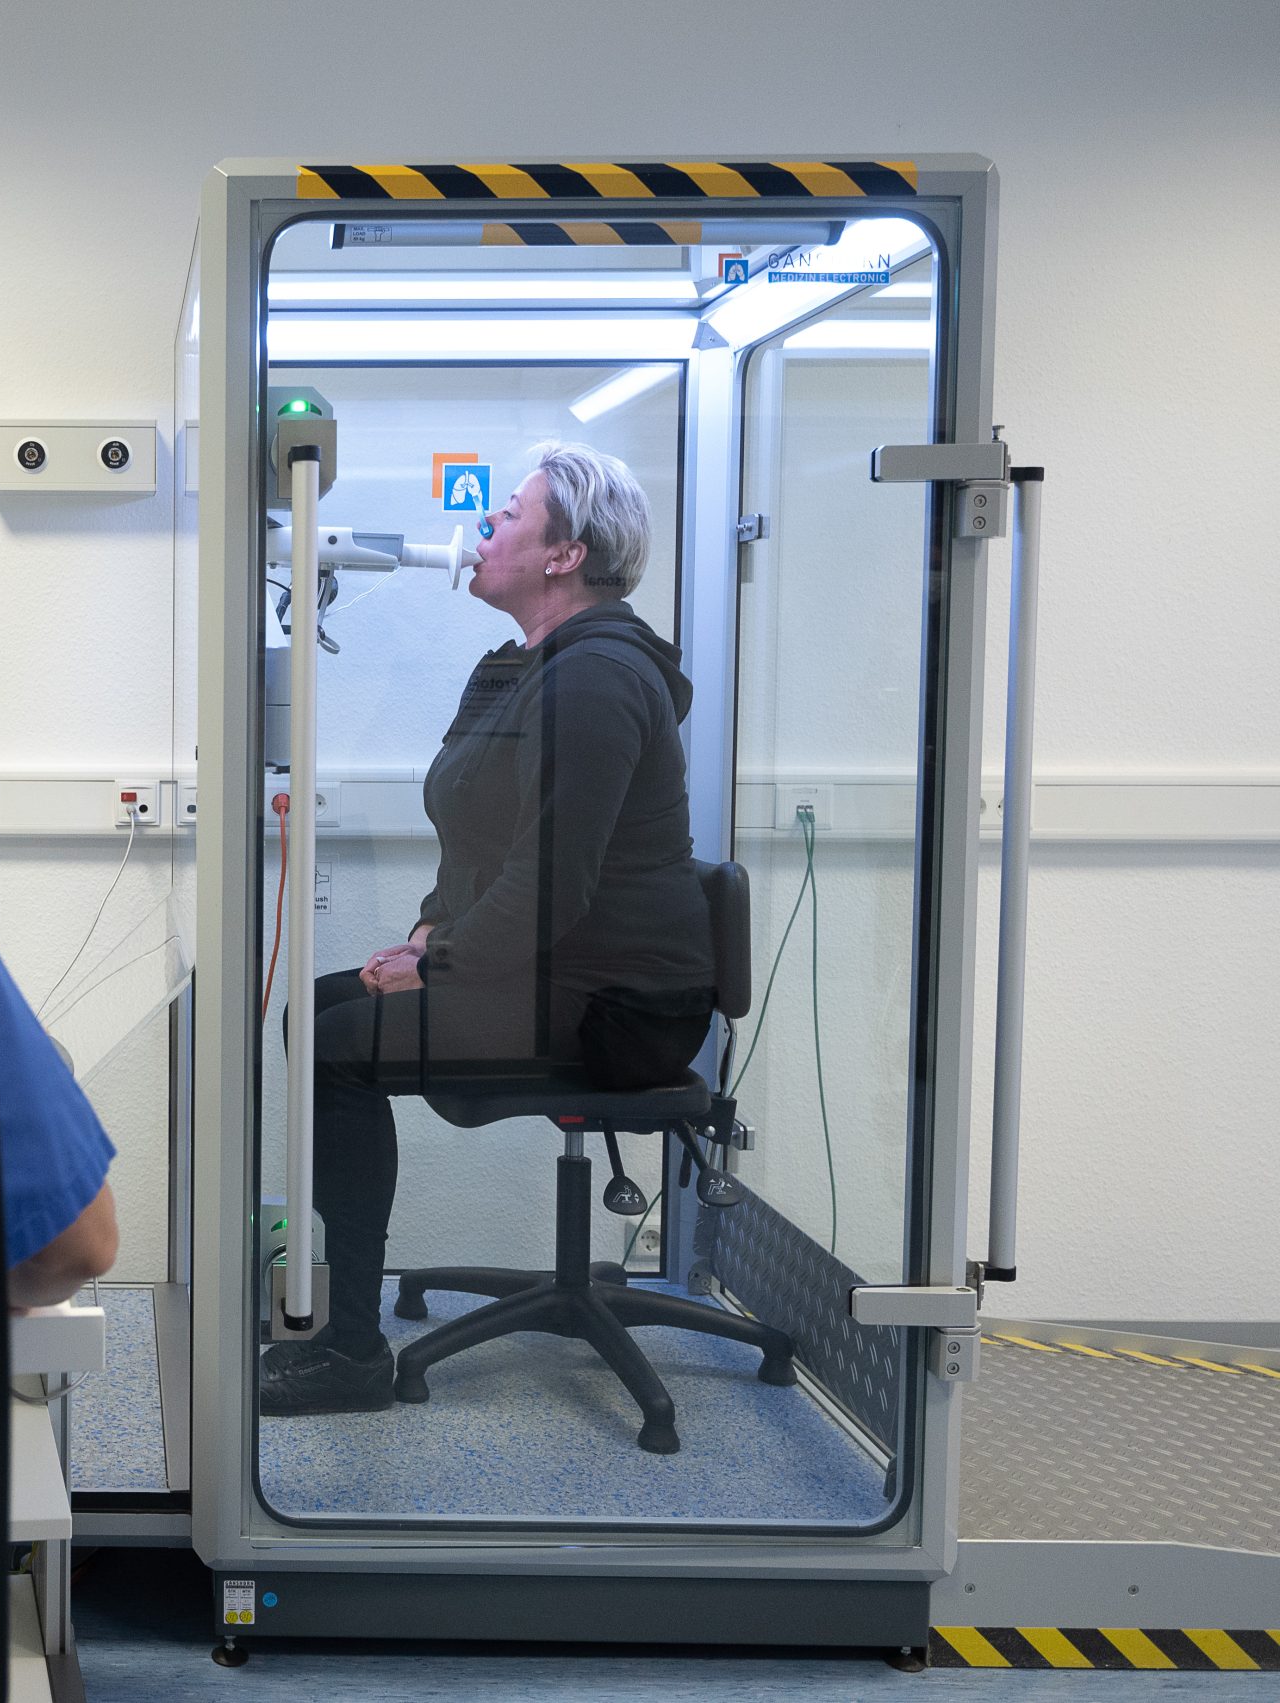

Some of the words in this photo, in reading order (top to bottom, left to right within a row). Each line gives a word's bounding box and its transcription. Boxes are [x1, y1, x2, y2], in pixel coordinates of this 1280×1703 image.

[768, 253, 890, 269] GANN
[771, 273, 816, 282] MEDIZIN
[820, 273, 886, 283] ELECTRONIC
